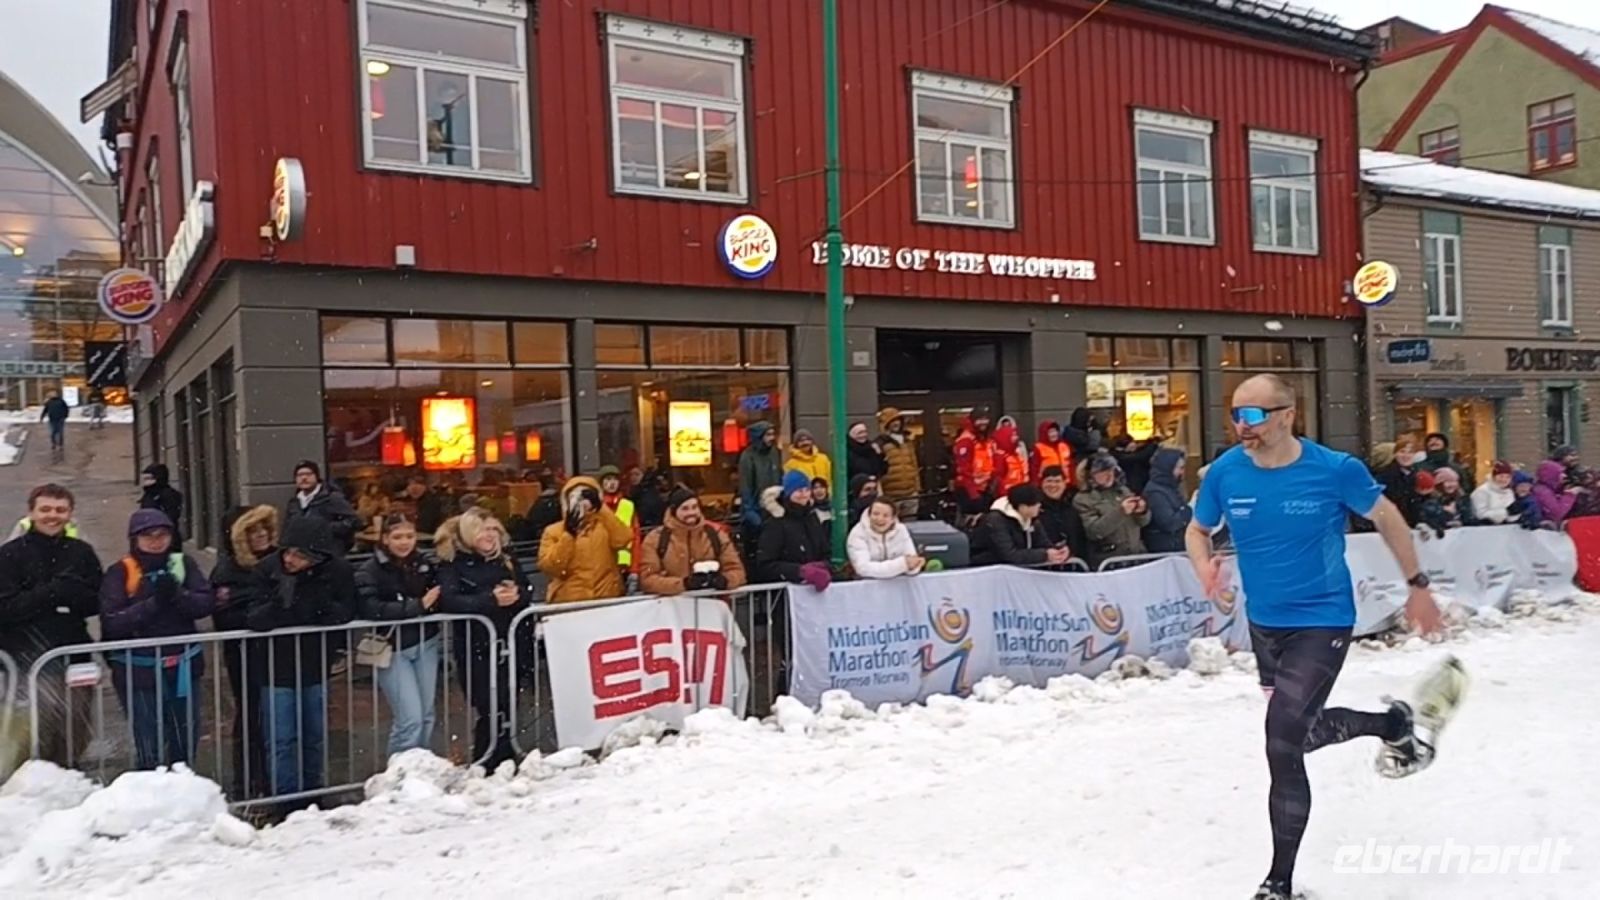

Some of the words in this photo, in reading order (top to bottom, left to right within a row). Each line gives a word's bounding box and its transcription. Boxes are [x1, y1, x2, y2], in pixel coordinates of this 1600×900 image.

[731, 239, 771, 262] KING
[896, 247, 930, 271] OF
[934, 251, 986, 274] THE
[988, 254, 1097, 281] WHOPPER
[111, 288, 153, 309] KING
[828, 620, 930, 651] MidnightSun
[828, 646, 911, 673] Marathon
